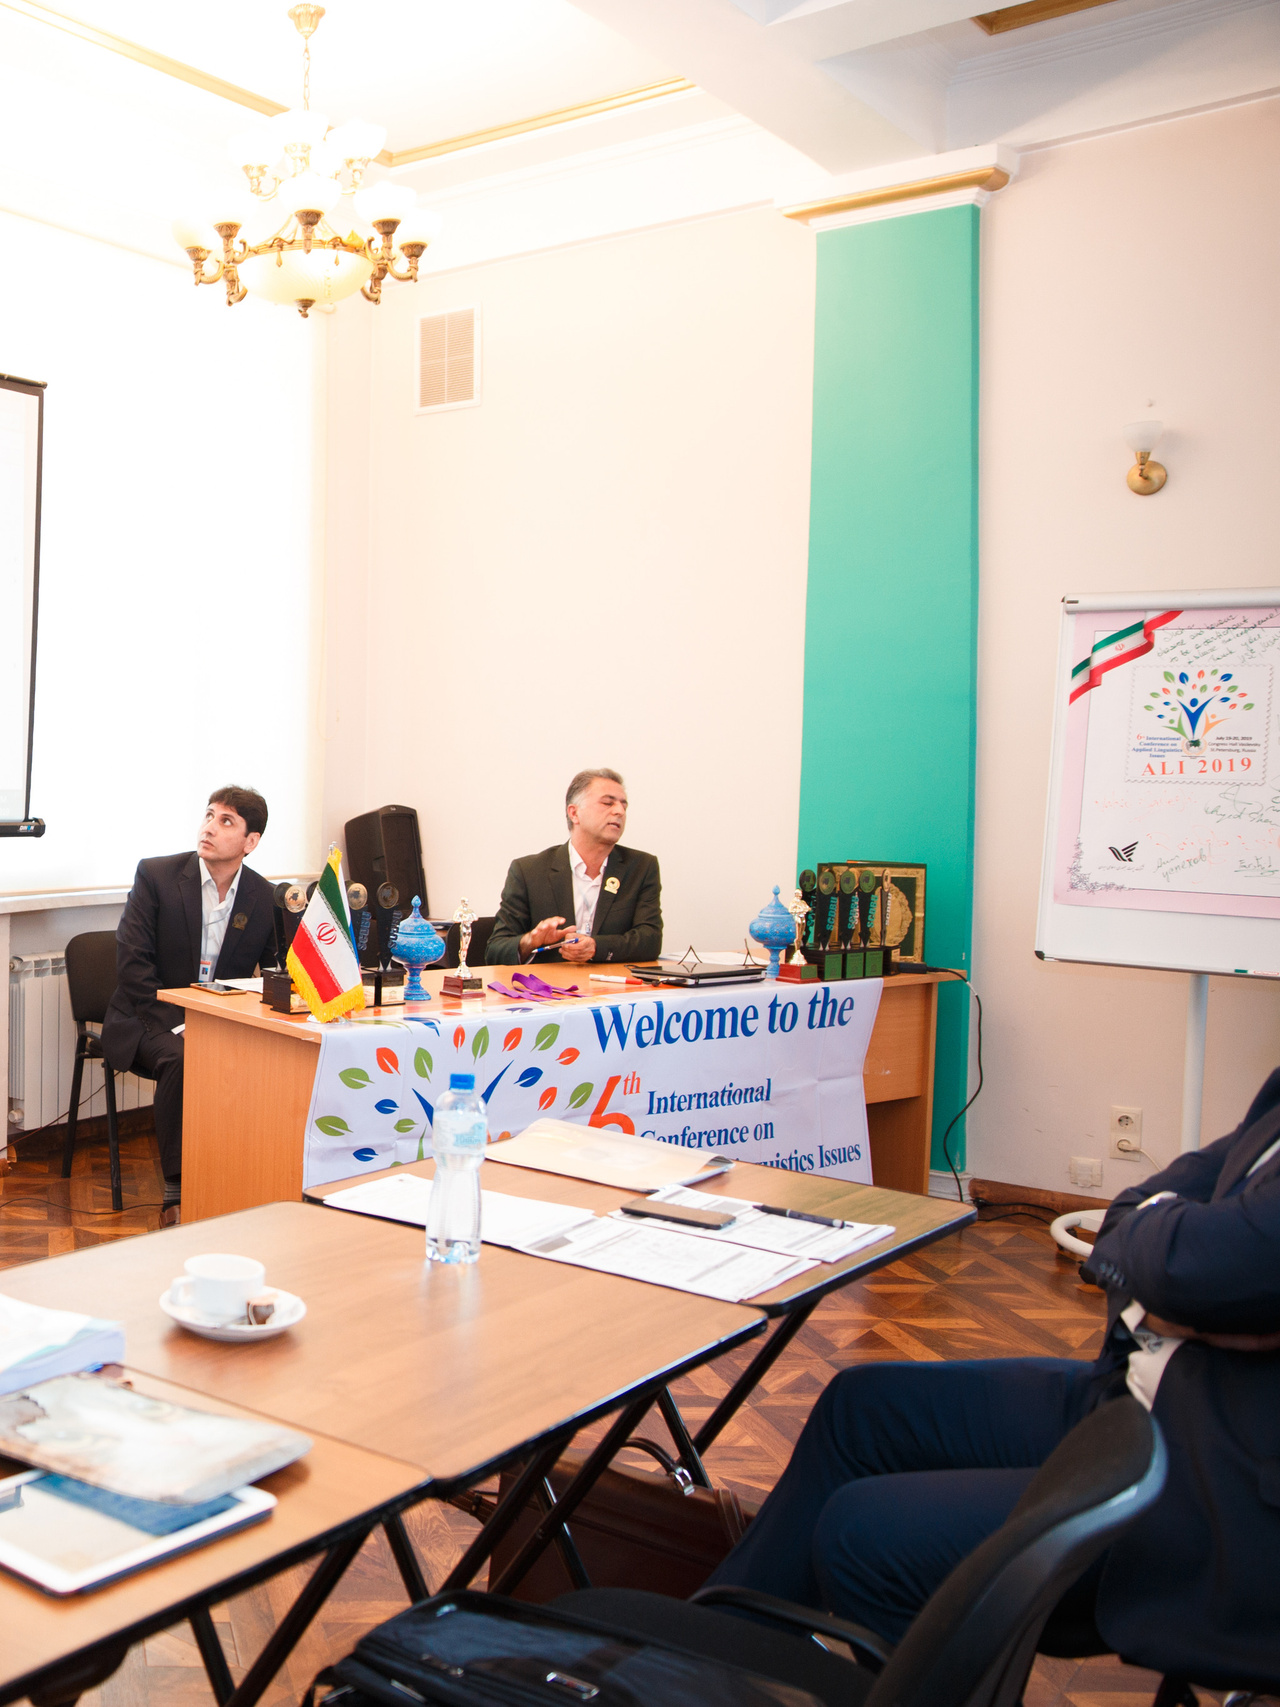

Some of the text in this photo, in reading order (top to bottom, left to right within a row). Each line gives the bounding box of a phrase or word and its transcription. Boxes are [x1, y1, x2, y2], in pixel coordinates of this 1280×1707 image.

[1141, 756, 1252, 777] ALI 2019
[587, 986, 856, 1054] Welcome to the
[645, 1077, 773, 1116] International
[753, 1120, 776, 1142] on
[818, 1143, 862, 1170] Issues
